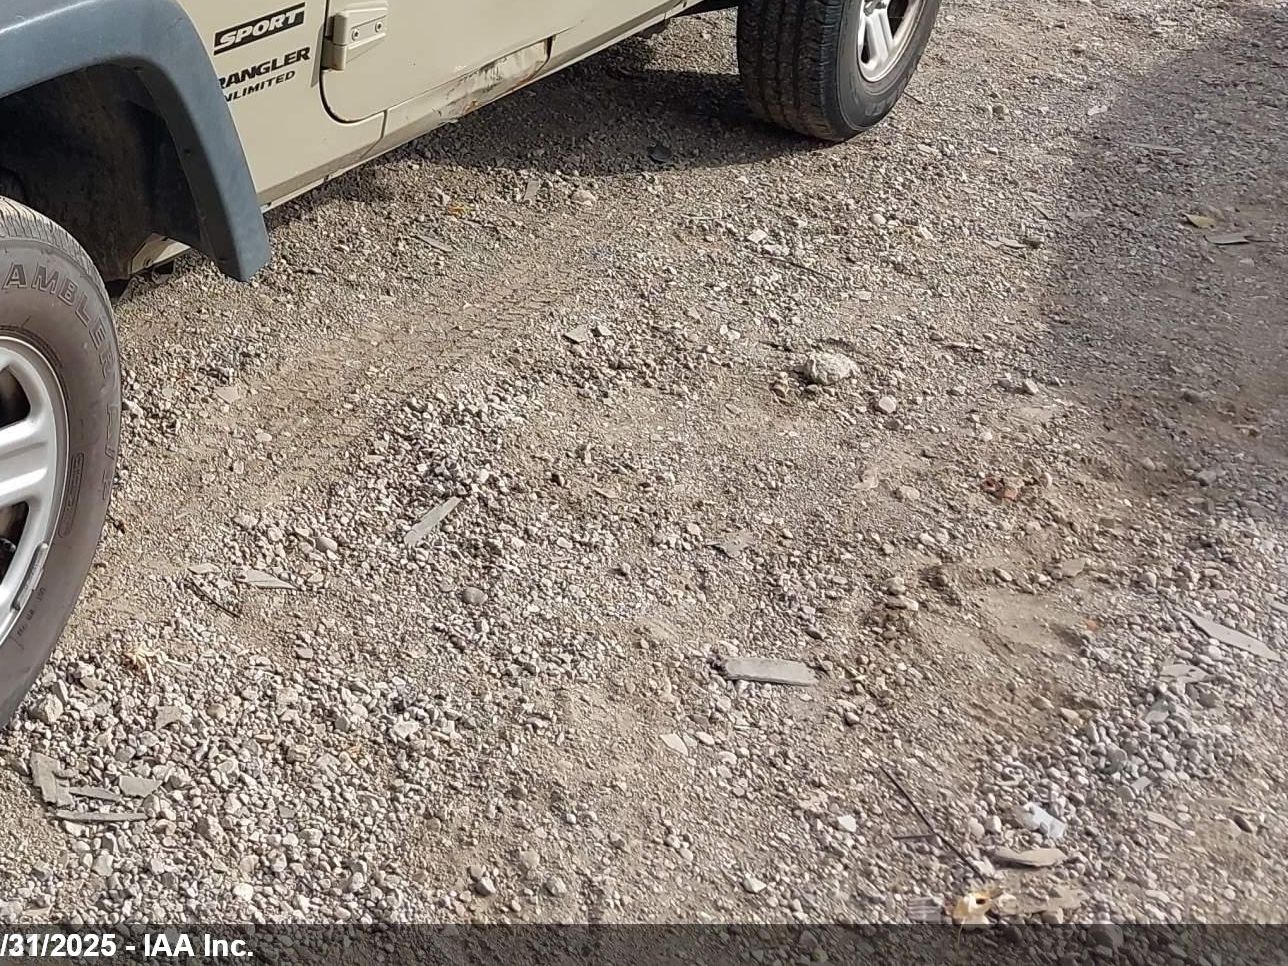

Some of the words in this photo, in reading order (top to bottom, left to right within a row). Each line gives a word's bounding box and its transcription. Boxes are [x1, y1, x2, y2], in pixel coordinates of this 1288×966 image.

[219, 10, 301, 45] SPORT
[218, 47, 310, 89] RANGLER
[224, 70, 296, 102] NLIMITED
